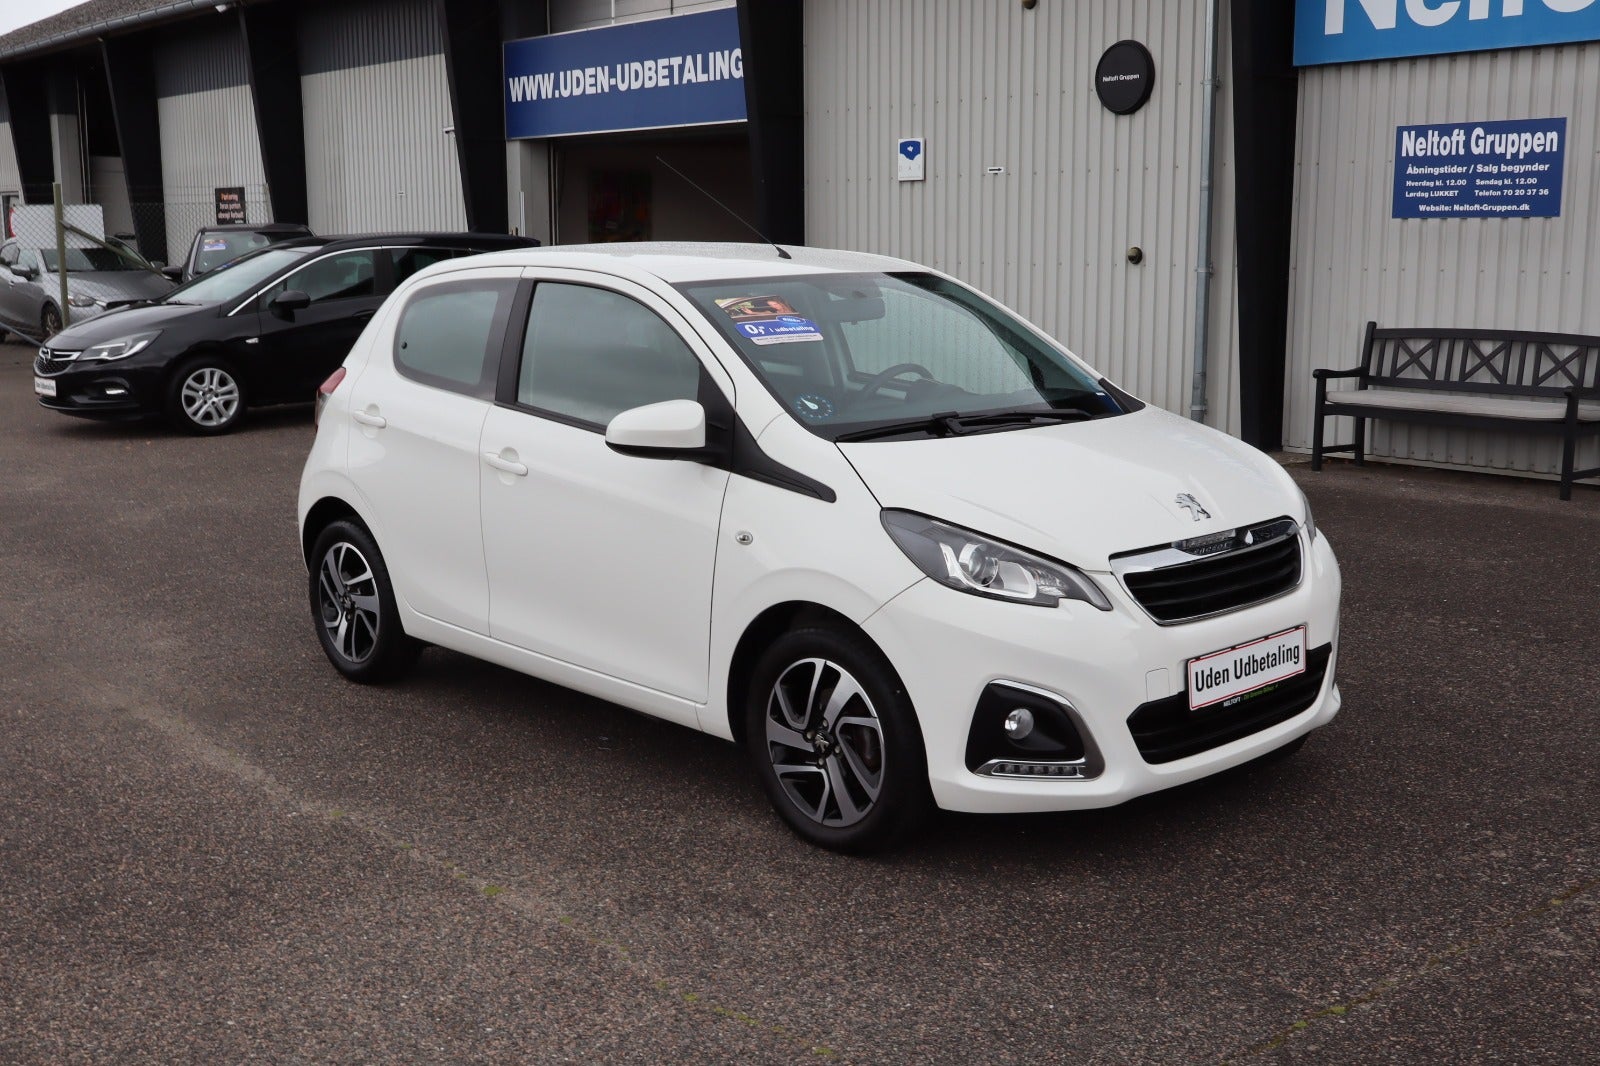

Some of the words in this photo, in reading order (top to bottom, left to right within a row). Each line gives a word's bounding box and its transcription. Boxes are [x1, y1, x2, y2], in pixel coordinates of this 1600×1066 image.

[509, 48, 744, 102] WWW.UDEN-UDBETALING
[1401, 128, 1466, 157] Neltoft
[1471, 127, 1558, 159] Gruppen
[1406, 163, 1467, 176] Åbningstider
[1476, 163, 1499, 174] Salg
[1500, 162, 1551, 173] begynder
[1475, 178, 1502, 186] Søndag
[1405, 190, 1429, 198] Lørdag
[1514, 188, 1525, 196] 20
[1453, 203, 1530, 212] Neltoft-Gruppen.dk
[1195, 667, 1230, 693] Uden
[1234, 644, 1300, 680] Udbetaling
